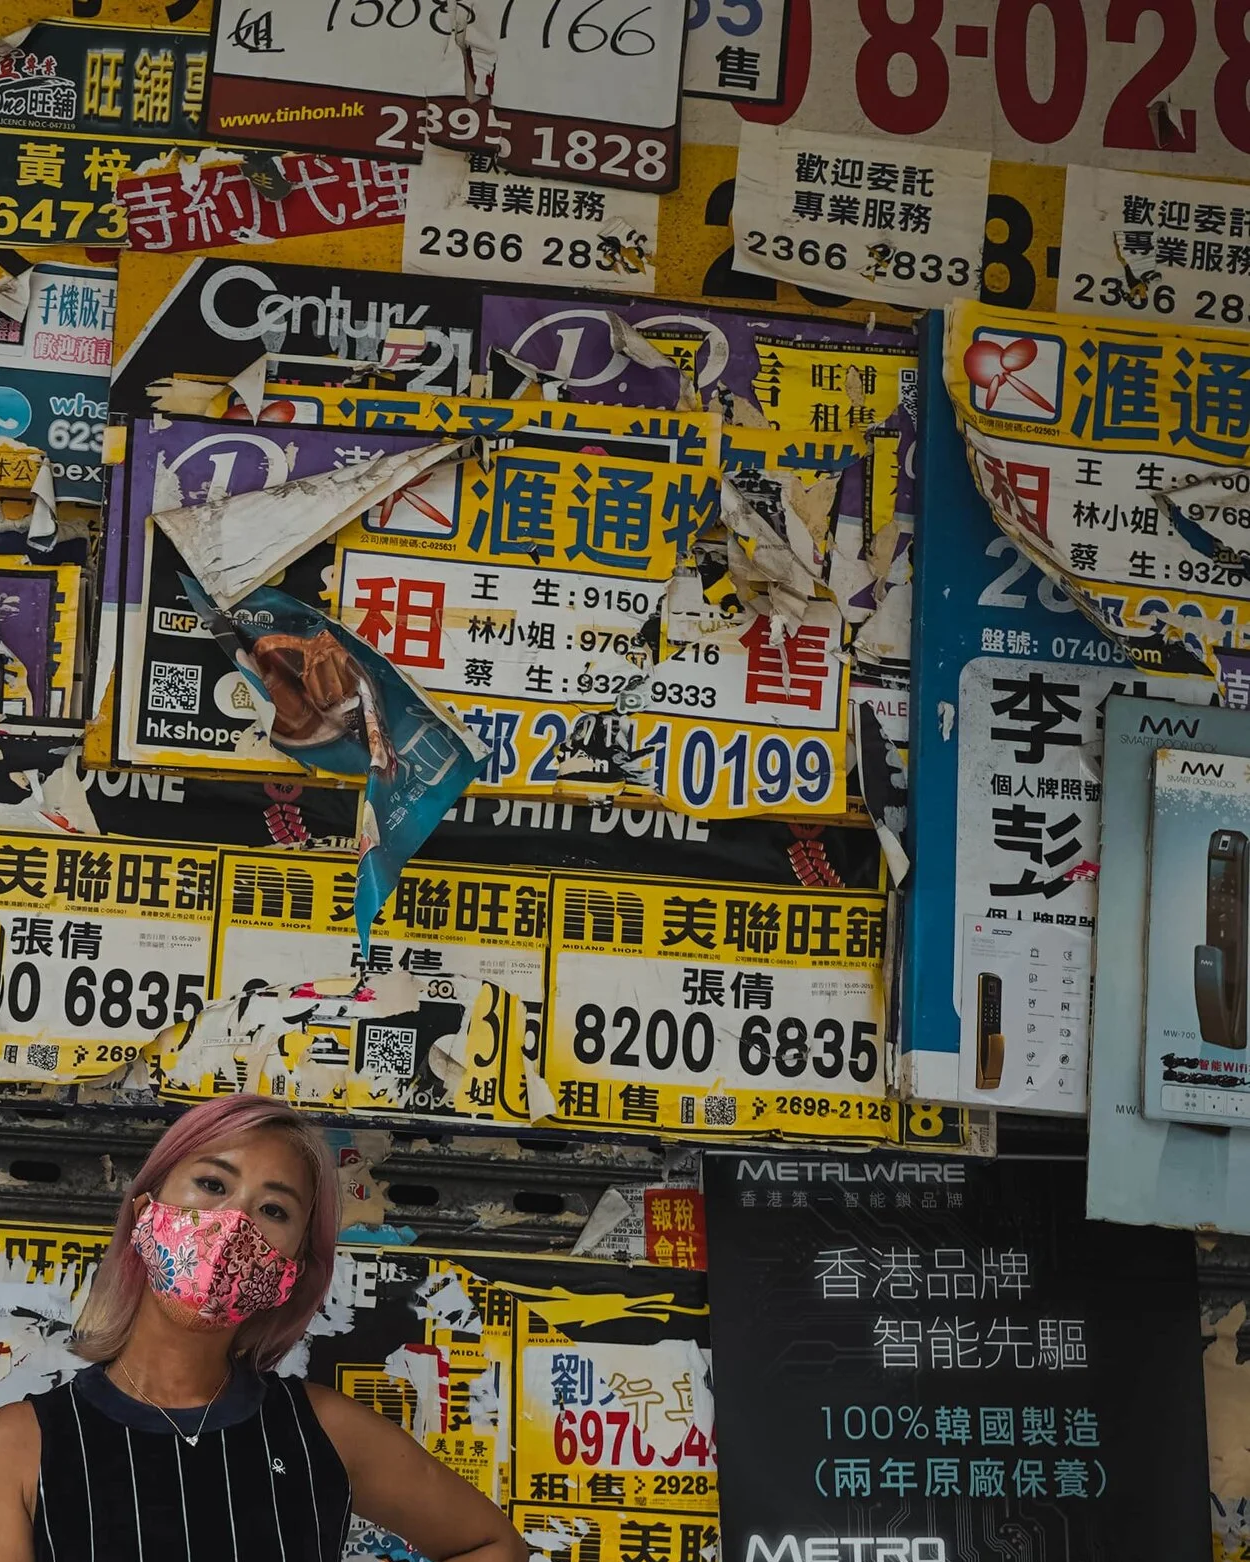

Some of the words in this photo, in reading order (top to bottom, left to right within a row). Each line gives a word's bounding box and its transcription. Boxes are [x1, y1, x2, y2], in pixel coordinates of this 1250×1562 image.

[714, 45, 761, 92] 售
[220, 102, 365, 131] www.tinhon.hk
[375, 104, 513, 159] 2395
[531, 125, 669, 182] 1828
[794, 152, 935, 198] 歡迎委託
[466, 180, 606, 223] 專業服務
[792, 189, 932, 235] 專業服務
[419, 226, 524, 263] 2366
[747, 229, 849, 272] 2366
[1070, 542, 1097, 572] 蔡
[583, 586, 650, 615] 9150
[353, 576, 448, 672] 租
[463, 658, 494, 689] 蔡
[651, 680, 718, 709] 9333
[989, 672, 1087, 766] 李
[9, 915, 104, 962] 張倩
[230, 917, 275, 927] MIDLAND
[279, 919, 312, 930] SHOPS
[660, 895, 886, 960] 美聯旺舖
[562, 943, 605, 952] MIDLAND
[612, 947, 643, 955] SHOPS
[63, 964, 206, 1032] 6835
[681, 967, 774, 1010] 張倩
[573, 1003, 715, 1073] 8200
[738, 1014, 879, 1083] 6835
[1163, 1028, 1197, 1041] MW-700
[558, 1079, 601, 1119] 租
[618, 1083, 660, 1124] 售
[775, 1096, 892, 1124] 2698-2128
[736, 1159, 966, 1184] METALWARE
[651, 1197, 697, 1232] 報稅
[813, 1245, 1032, 1301] 香港品牌
[527, 1336, 570, 1345] MIDLAND
[872, 1314, 1089, 1371] 智能先驅
[820, 1404, 1102, 1448] 100%韓國製造
[813, 1457, 1109, 1500] (兩年原廠保養)
